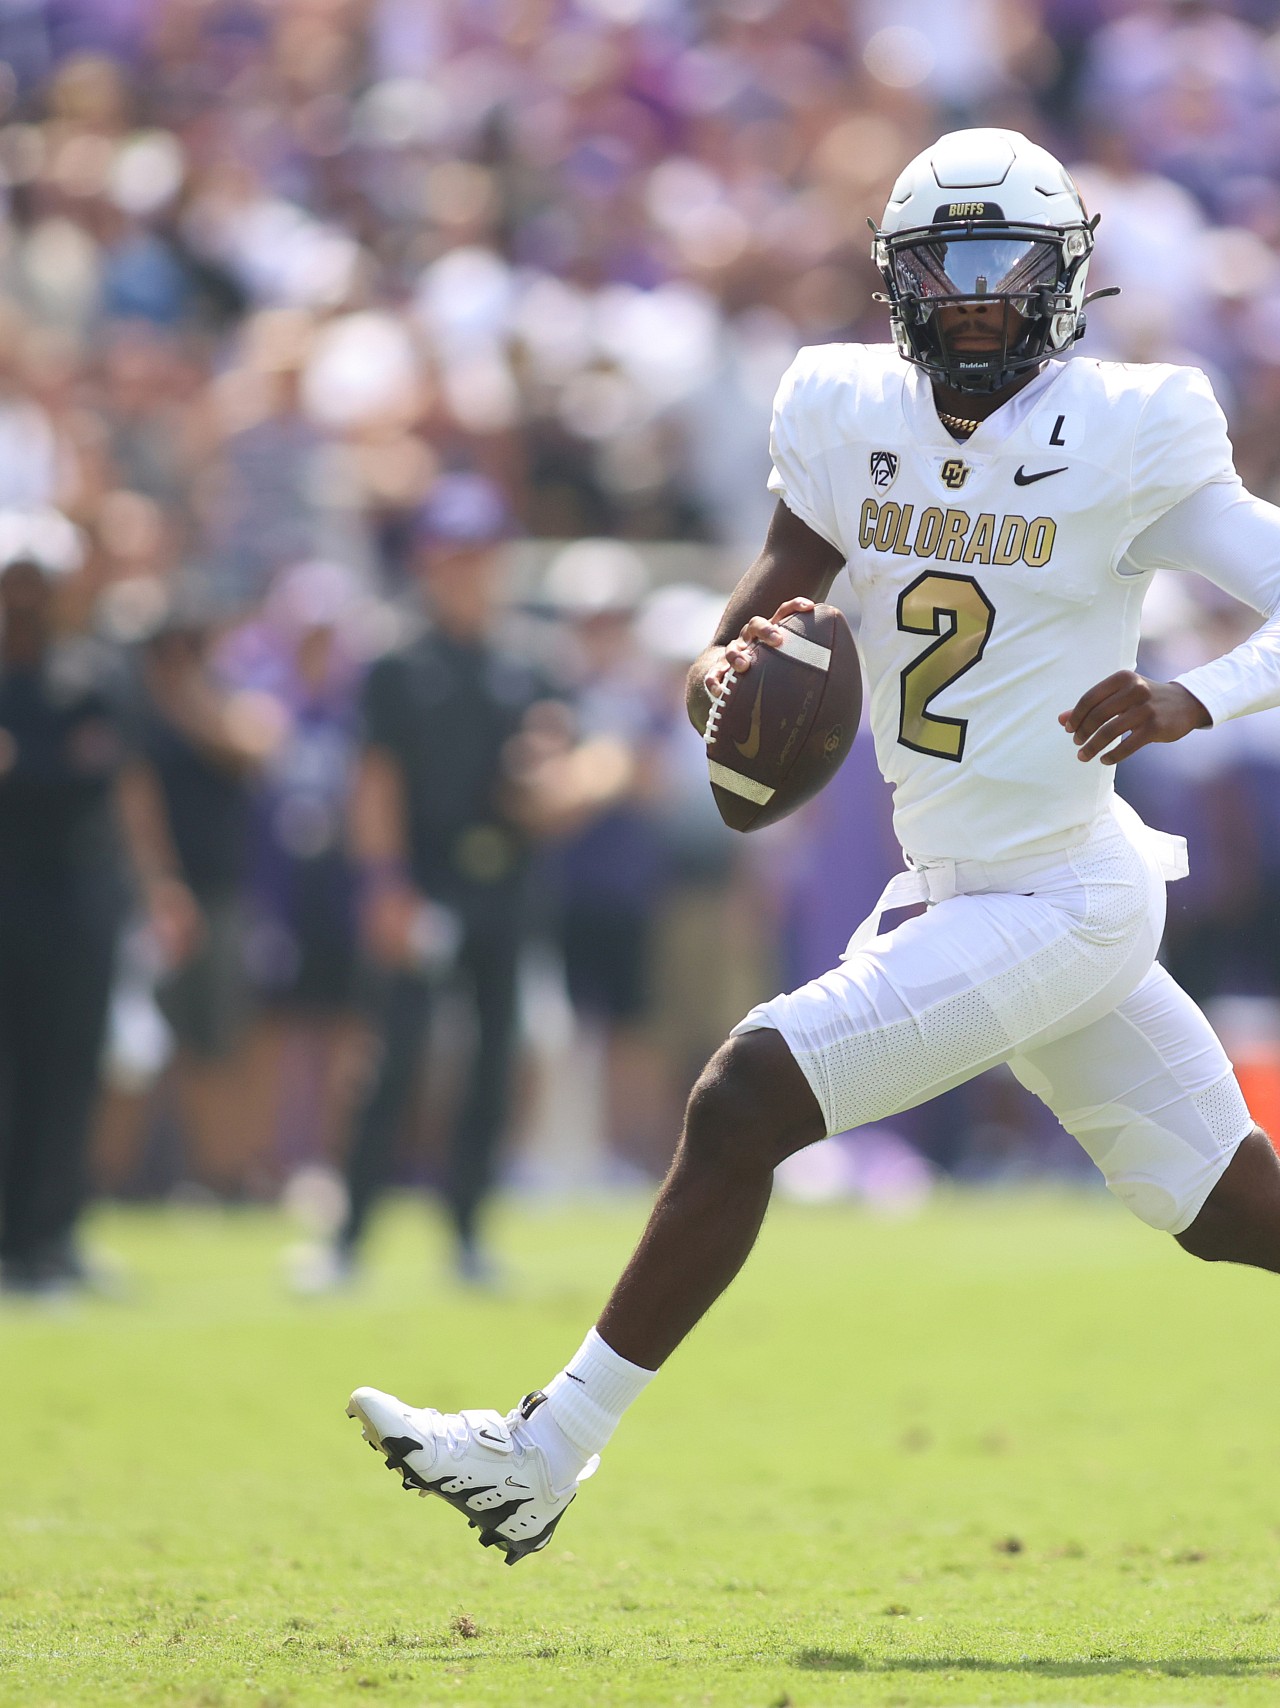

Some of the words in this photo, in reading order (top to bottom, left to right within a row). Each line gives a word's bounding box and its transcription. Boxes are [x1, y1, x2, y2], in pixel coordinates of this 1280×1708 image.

[948, 202, 985, 217] BUFFS
[1049, 414, 1066, 446] L
[941, 459, 970, 489] CU
[858, 498, 1057, 568] COLORADO
[896, 569, 996, 763] 2
